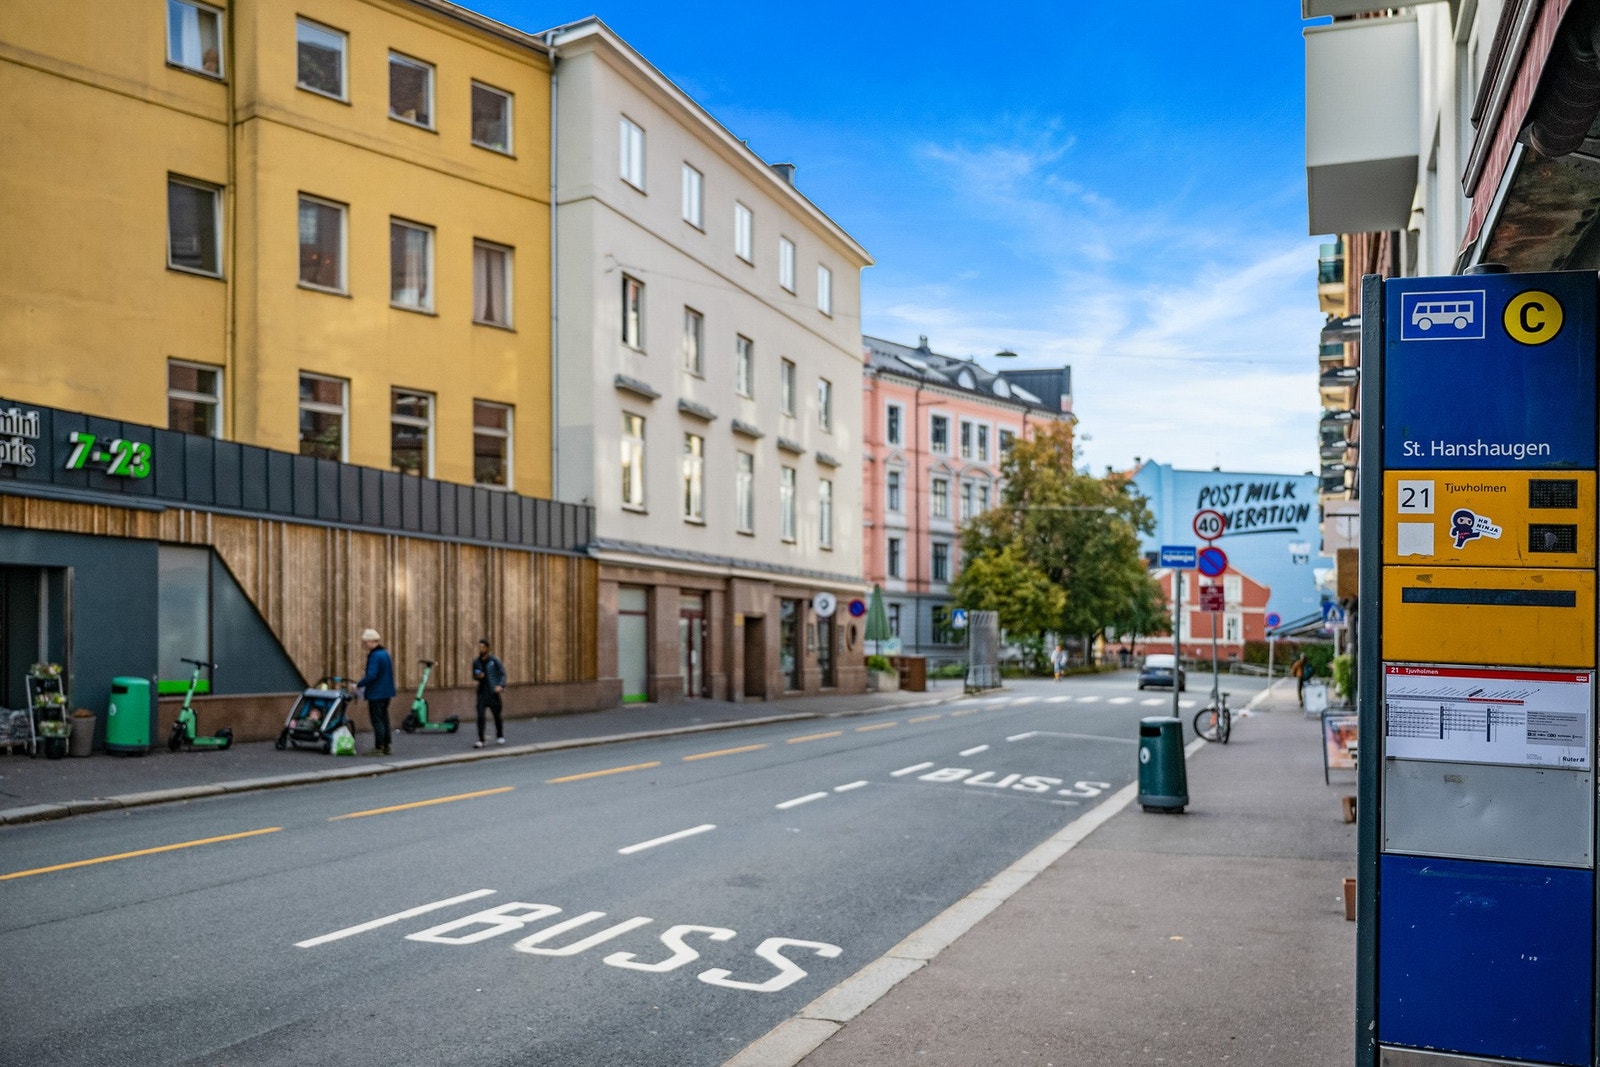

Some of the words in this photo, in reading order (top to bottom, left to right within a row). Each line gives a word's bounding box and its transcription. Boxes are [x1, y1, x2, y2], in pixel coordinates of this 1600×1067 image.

[1520, 302, 1545, 332] C
[1403, 440, 1425, 457] St.
[1431, 439, 1551, 460] Hanshaugen
[1197, 483, 1243, 509] POST
[1244, 481, 1297, 503] MILK
[1401, 487, 1429, 508] 21
[1444, 482, 1507, 493] Tjuvholmen
[1198, 517, 1220, 533] 40
[1222, 503, 1310, 530] NERATION
[1476, 523, 1499, 534] NINJA
[1405, 667, 1439, 675] Tjuvholmen
[917, 767, 1111, 798] BUSS
[404, 902, 843, 992] BUSS
